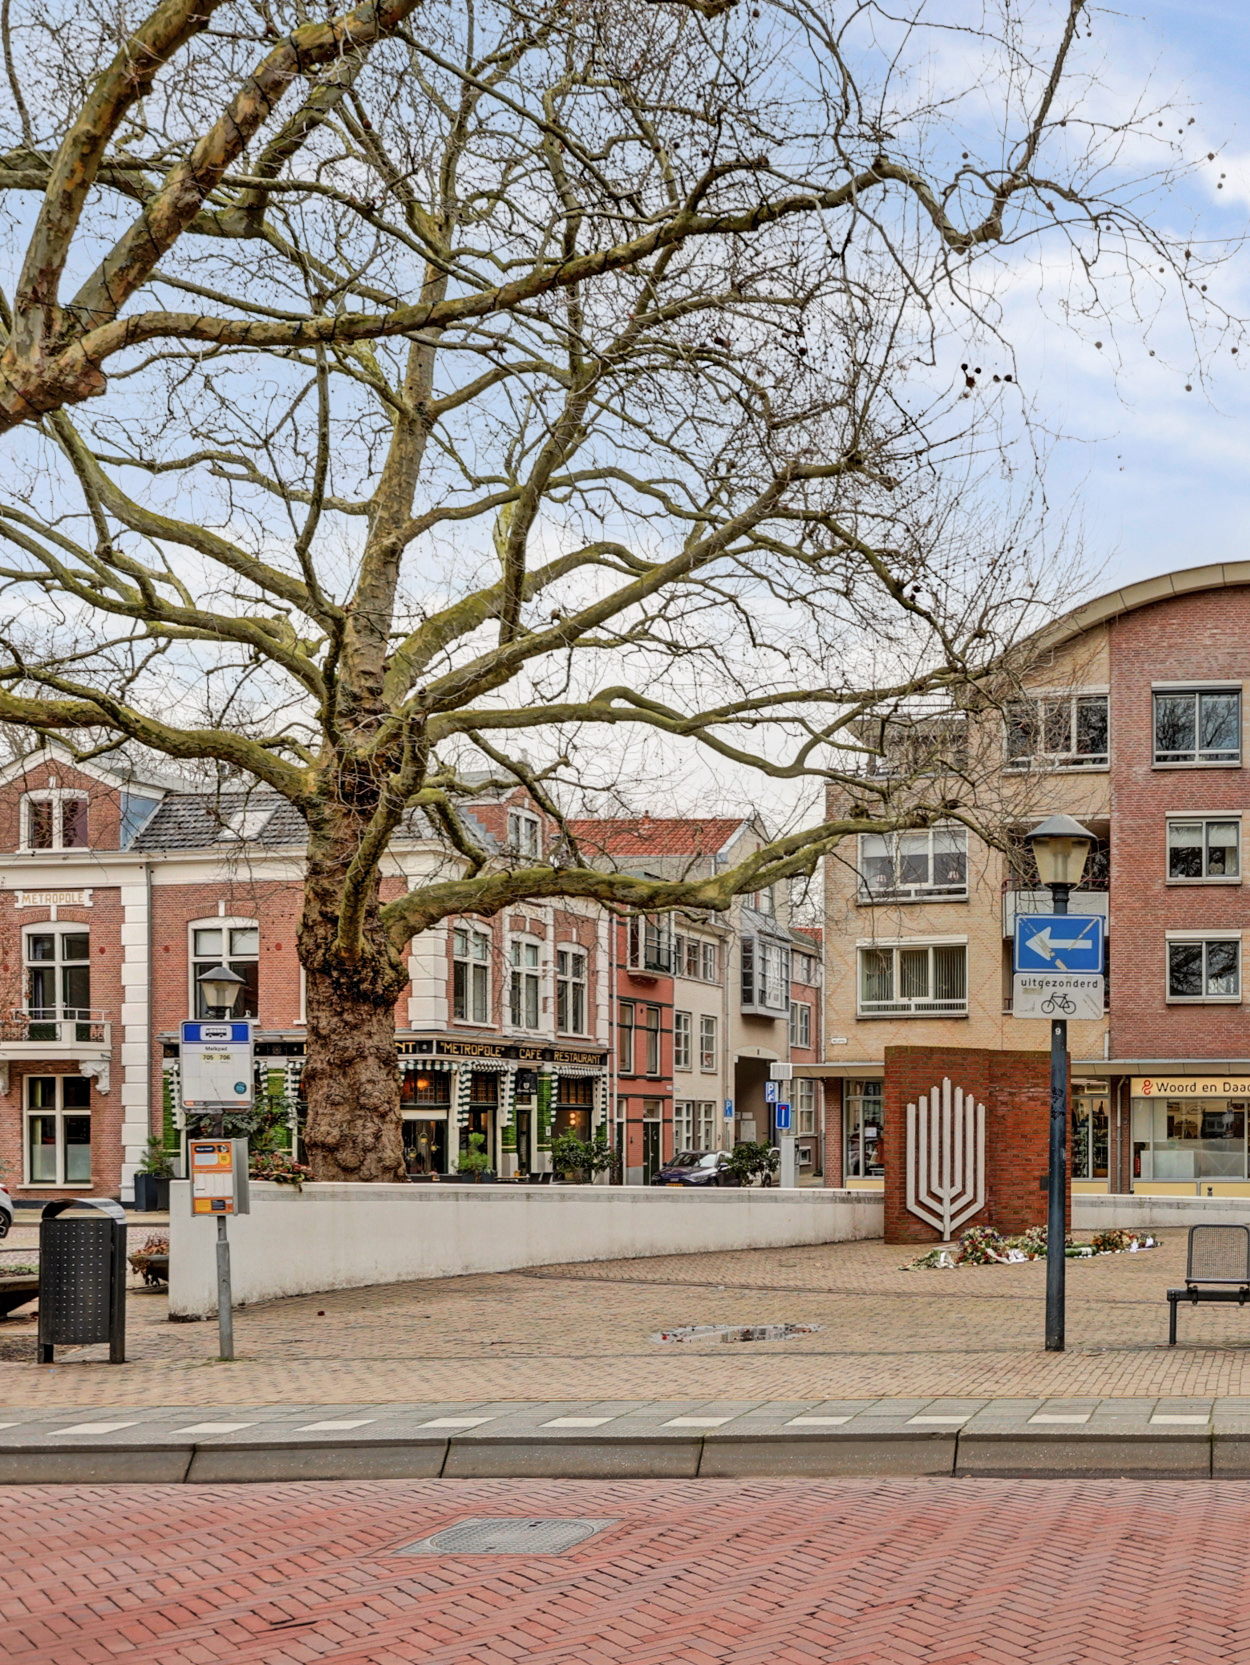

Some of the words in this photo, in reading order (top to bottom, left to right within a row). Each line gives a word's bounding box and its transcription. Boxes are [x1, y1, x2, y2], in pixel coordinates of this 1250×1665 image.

[22, 893, 84, 904] METROPOLE
[1021, 979, 1098, 989] uitgezonderd
[1054, 1027, 1062, 1036] 9
[554, 1051, 601, 1065] RESTAURANT
[1156, 1082, 1196, 1092] Woord
[1202, 1084, 1217, 1092] en
